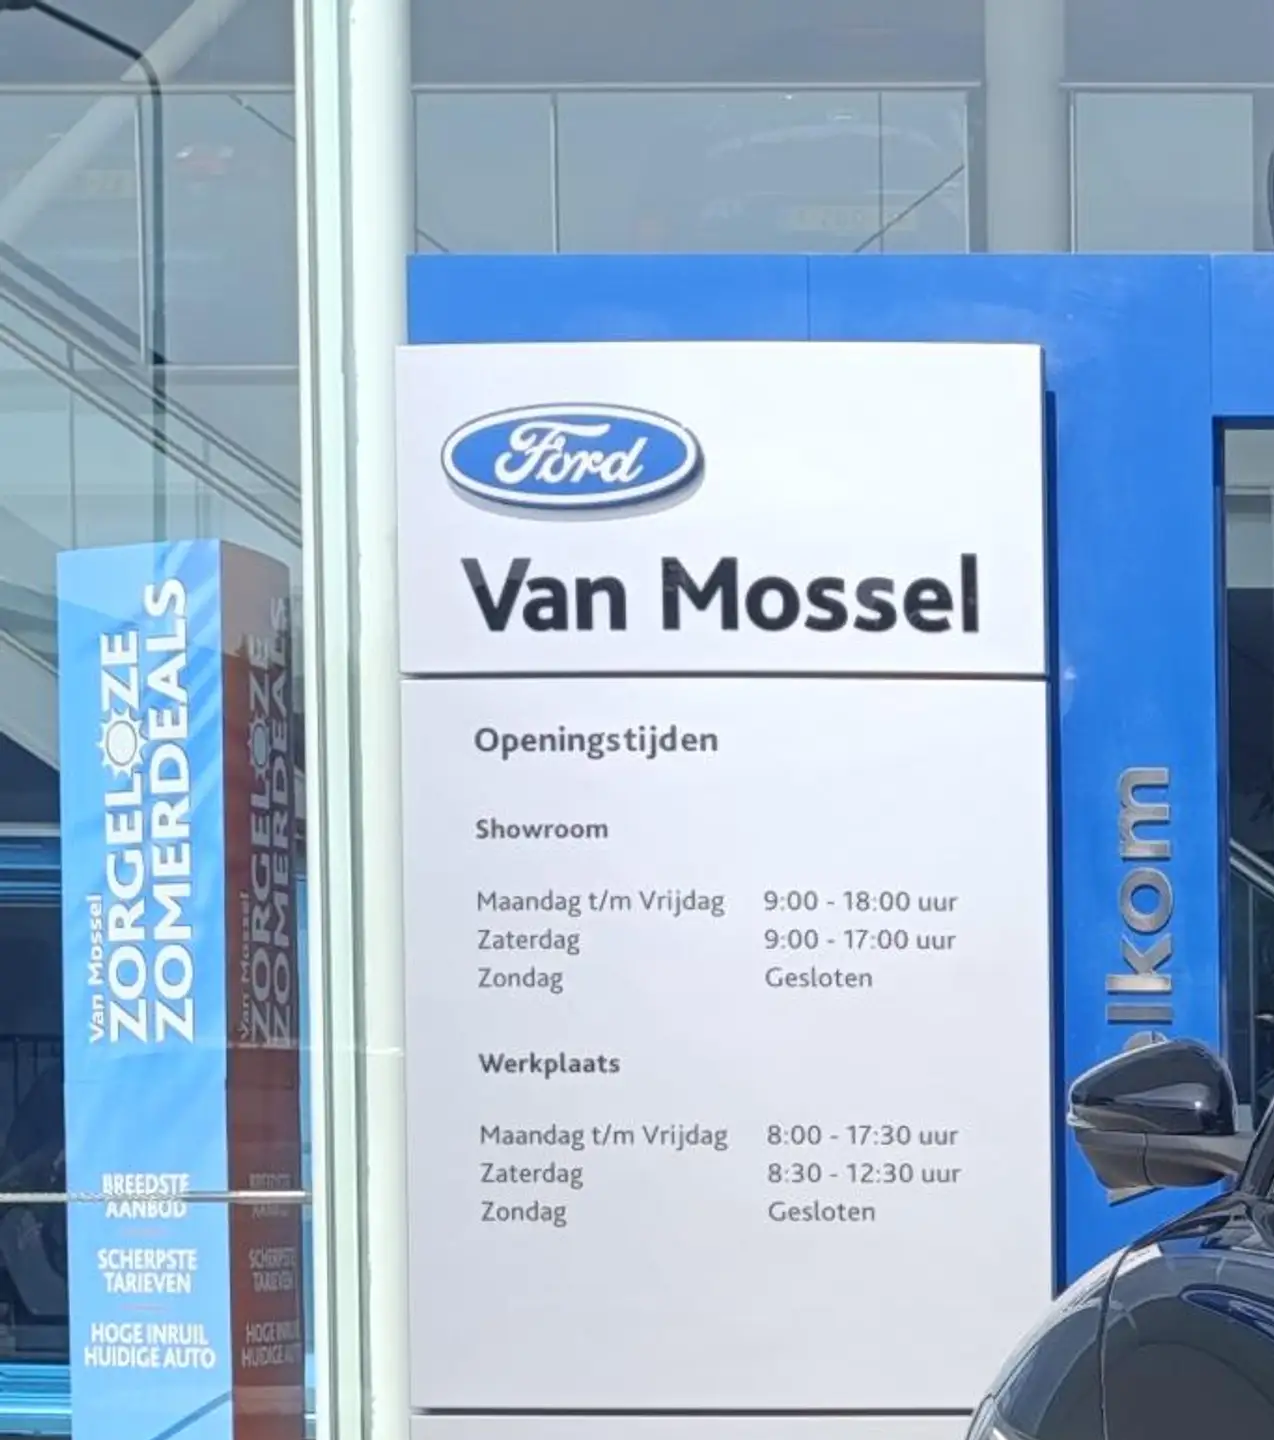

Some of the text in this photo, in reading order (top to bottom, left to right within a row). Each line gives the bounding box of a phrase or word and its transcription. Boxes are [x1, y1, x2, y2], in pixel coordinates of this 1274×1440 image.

[494, 421, 648, 484] Ford
[462, 554, 979, 633] Van Mossel
[474, 724, 718, 761] Openingstijden
[144, 577, 194, 1043] ZOMERDEALS
[475, 817, 608, 840] Showroom
[477, 890, 582, 917] Maandag
[588, 890, 632, 913] t/m
[639, 889, 725, 918] Vrijdag
[764, 890, 818, 911] 9:00
[844, 891, 911, 912] 18:00
[918, 897, 957, 912] uur
[477, 928, 581, 956] Zaterdag
[764, 928, 819, 950] 9:00
[844, 929, 909, 950] 17:00
[917, 936, 957, 950] uur
[86, 893, 105, 1042] Van Mossel
[477, 966, 873, 995] Zondag Gesloten
[478, 1052, 620, 1080] Werkplaats
[480, 1124, 585, 1152] Maandag
[591, 1124, 635, 1147] t/m
[642, 1123, 728, 1152] Vrijdag
[767, 1124, 822, 1145] 8:00
[847, 1125, 911, 1146] 17:30
[919, 1130, 958, 1146] uur
[102, 1173, 190, 1196] BREEDSTE
[480, 1161, 584, 1190] Zaterdag
[768, 1162, 822, 1184] 8:30
[846, 1162, 914, 1184] 12:30
[921, 1168, 961, 1183] uur
[481, 1199, 875, 1229] Zondag Gesloten
[97, 1249, 198, 1270] SCHERPSTE
[104, 1272, 192, 1293] TARIEVEN
[91, 1323, 209, 1345] HOGE INRUIL
[84, 1347, 216, 1369] HUIDIGE AUTO
